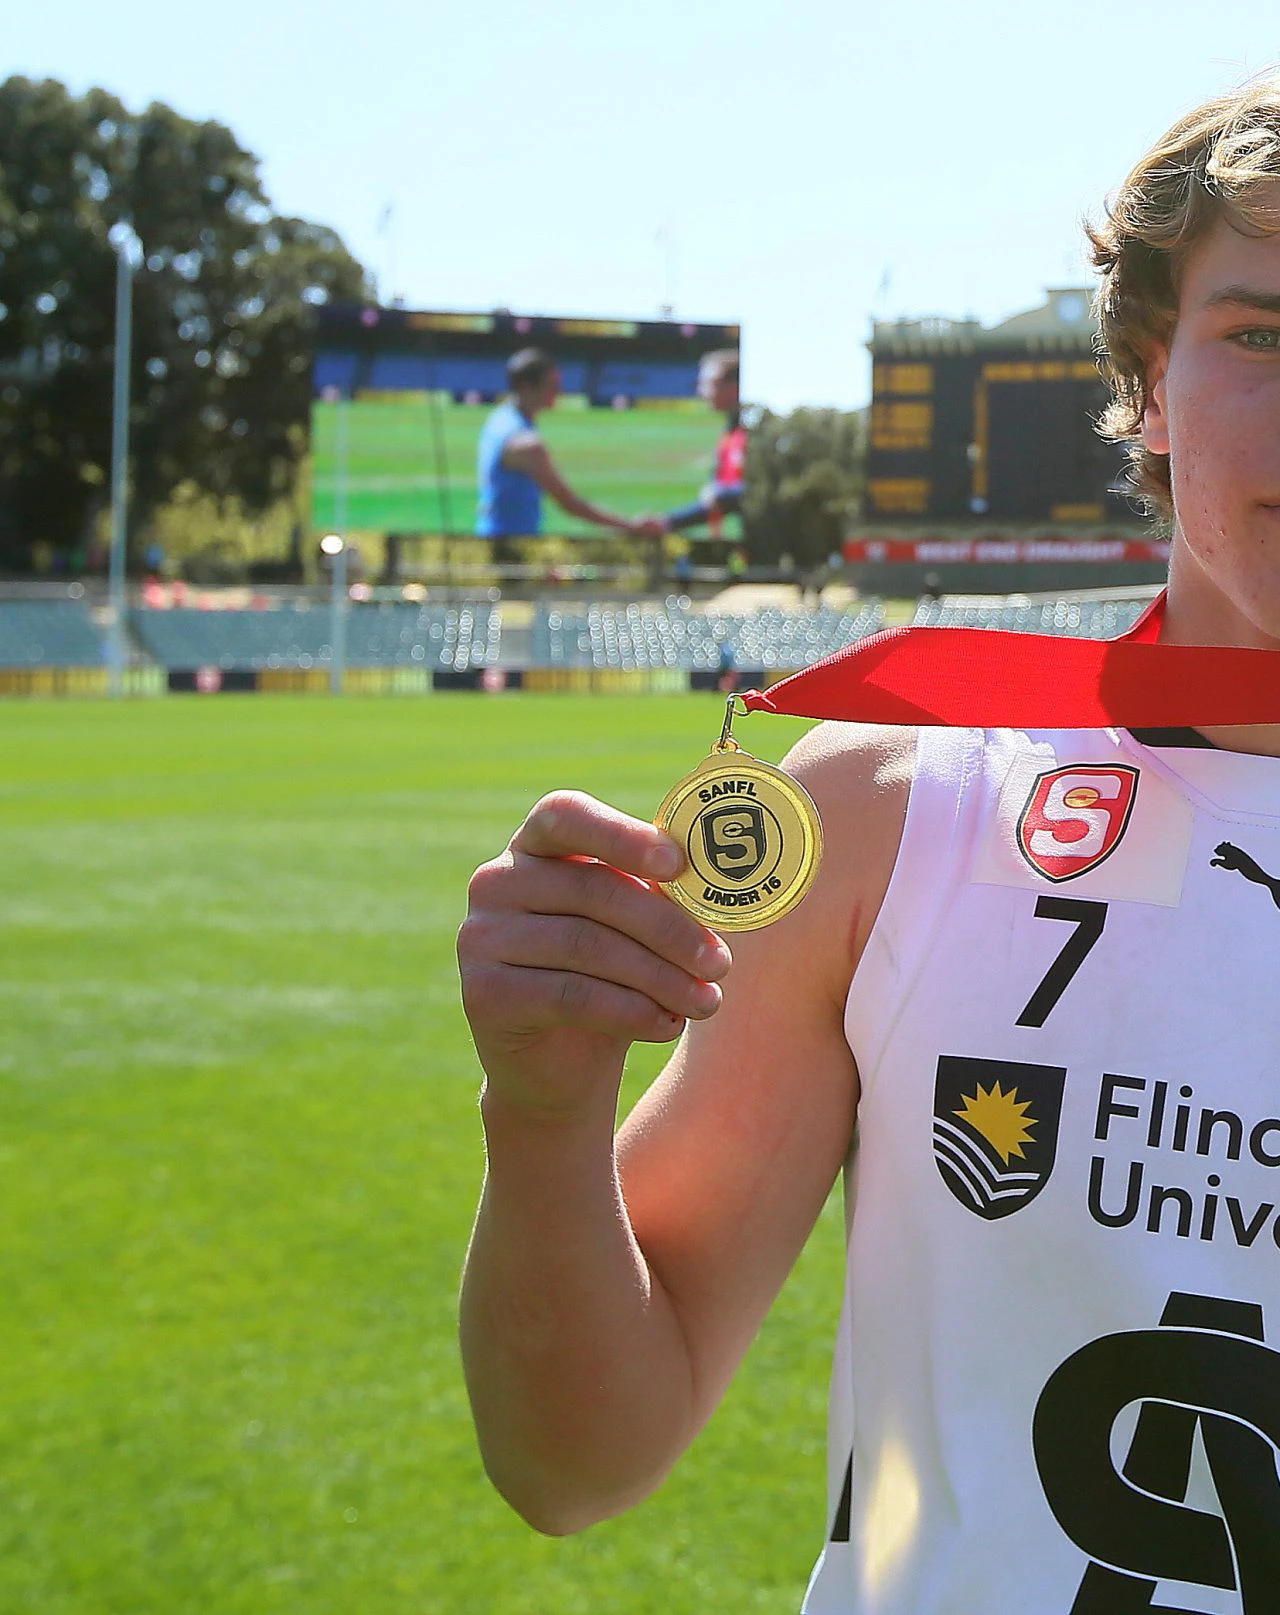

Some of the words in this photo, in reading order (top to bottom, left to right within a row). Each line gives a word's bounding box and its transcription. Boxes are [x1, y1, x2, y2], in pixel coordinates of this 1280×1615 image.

[698, 781, 757, 803] SANFL
[703, 886, 761, 907] UNDER
[762, 876, 782, 895] 16
[1014, 895, 1109, 1028] 7
